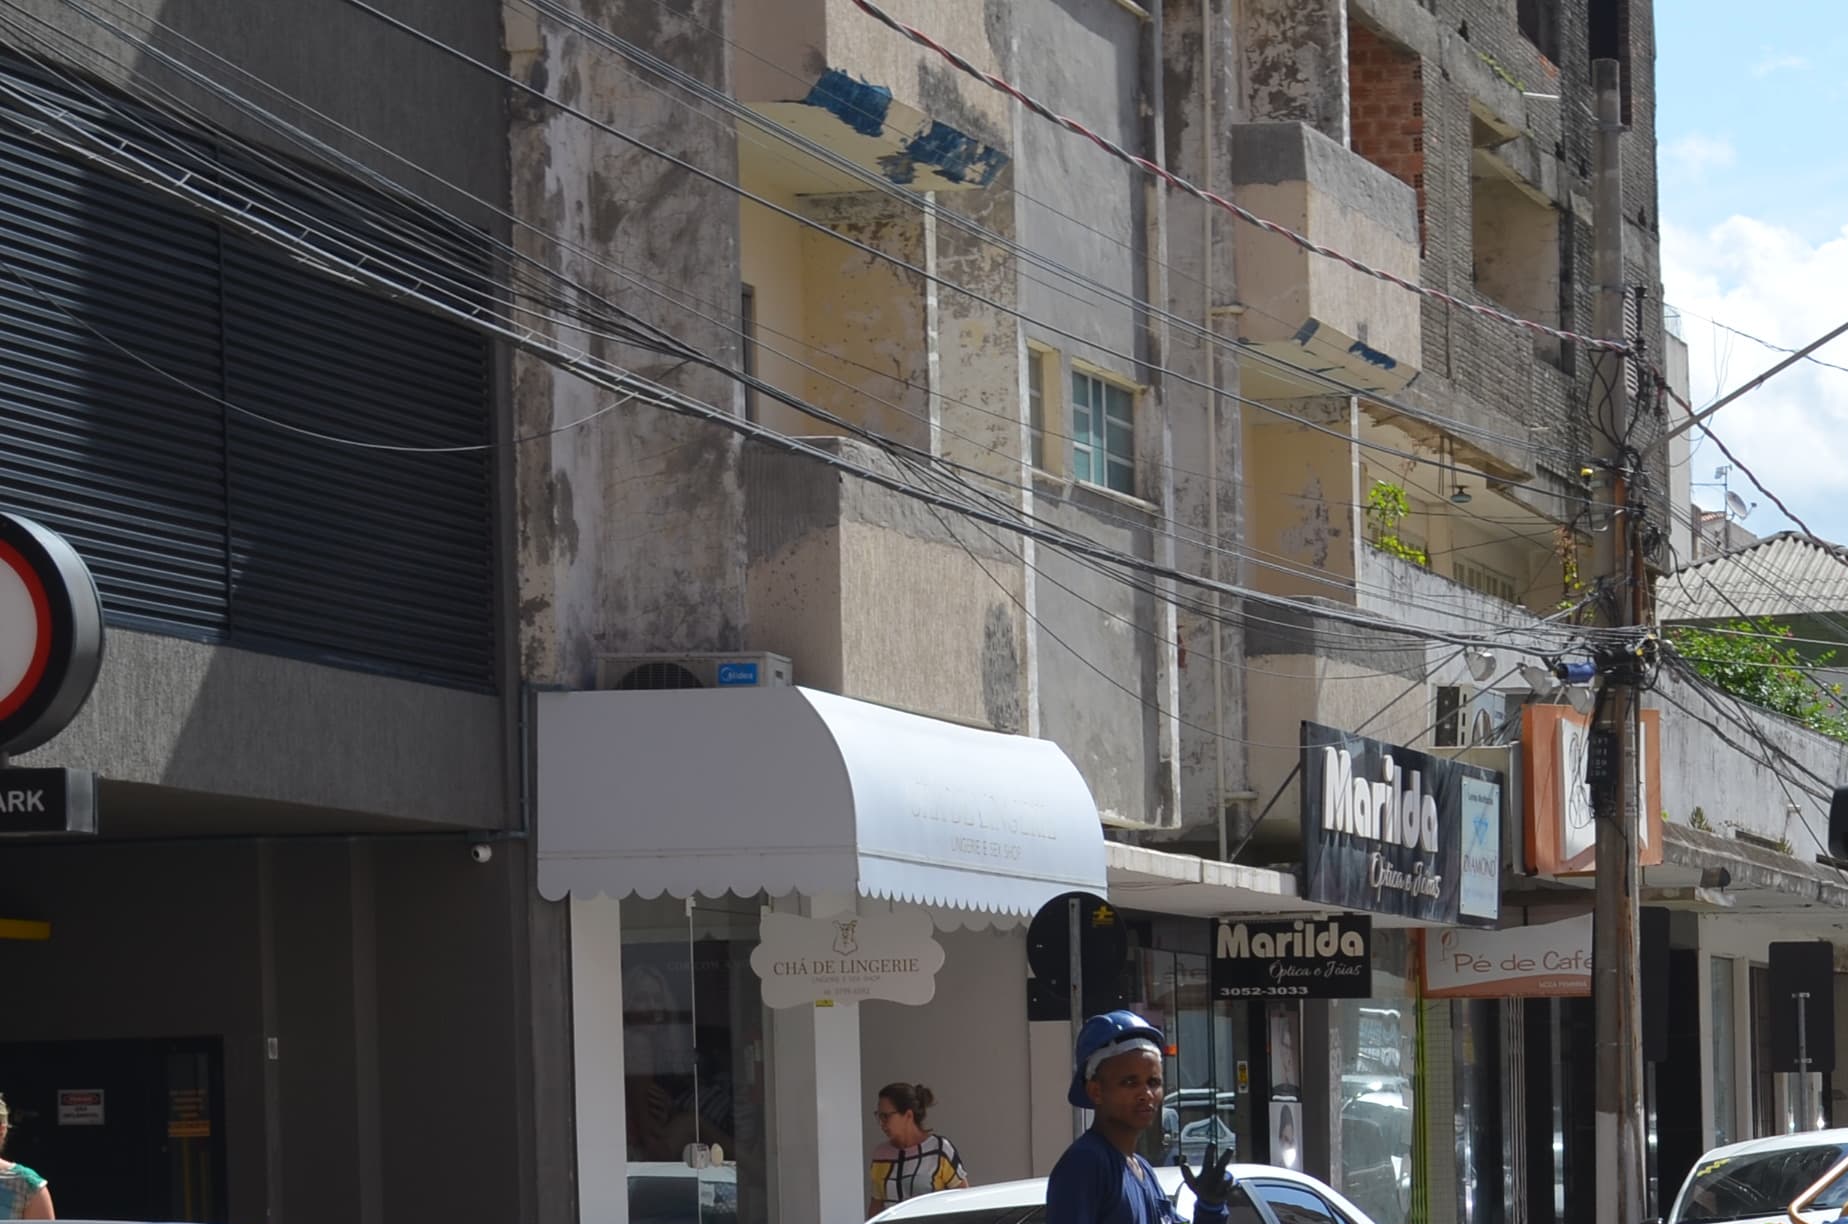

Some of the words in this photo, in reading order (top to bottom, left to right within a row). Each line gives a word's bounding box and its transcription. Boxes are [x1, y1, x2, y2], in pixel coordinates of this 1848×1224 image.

[1322, 746, 1439, 853] Marilda
[1370, 844, 1405, 902] Óptica
[1216, 920, 1365, 959] Marilda
[773, 957, 808, 976] CHÁ
[813, 960, 836, 974] DE
[840, 958, 920, 974] LINGERIE
[1268, 960, 1312, 984] Óptica
[1313, 968, 1321, 977] e
[1453, 953, 1493, 974] Pé
[1500, 954, 1537, 972] de
[1220, 986, 1309, 996] 3052-3033
